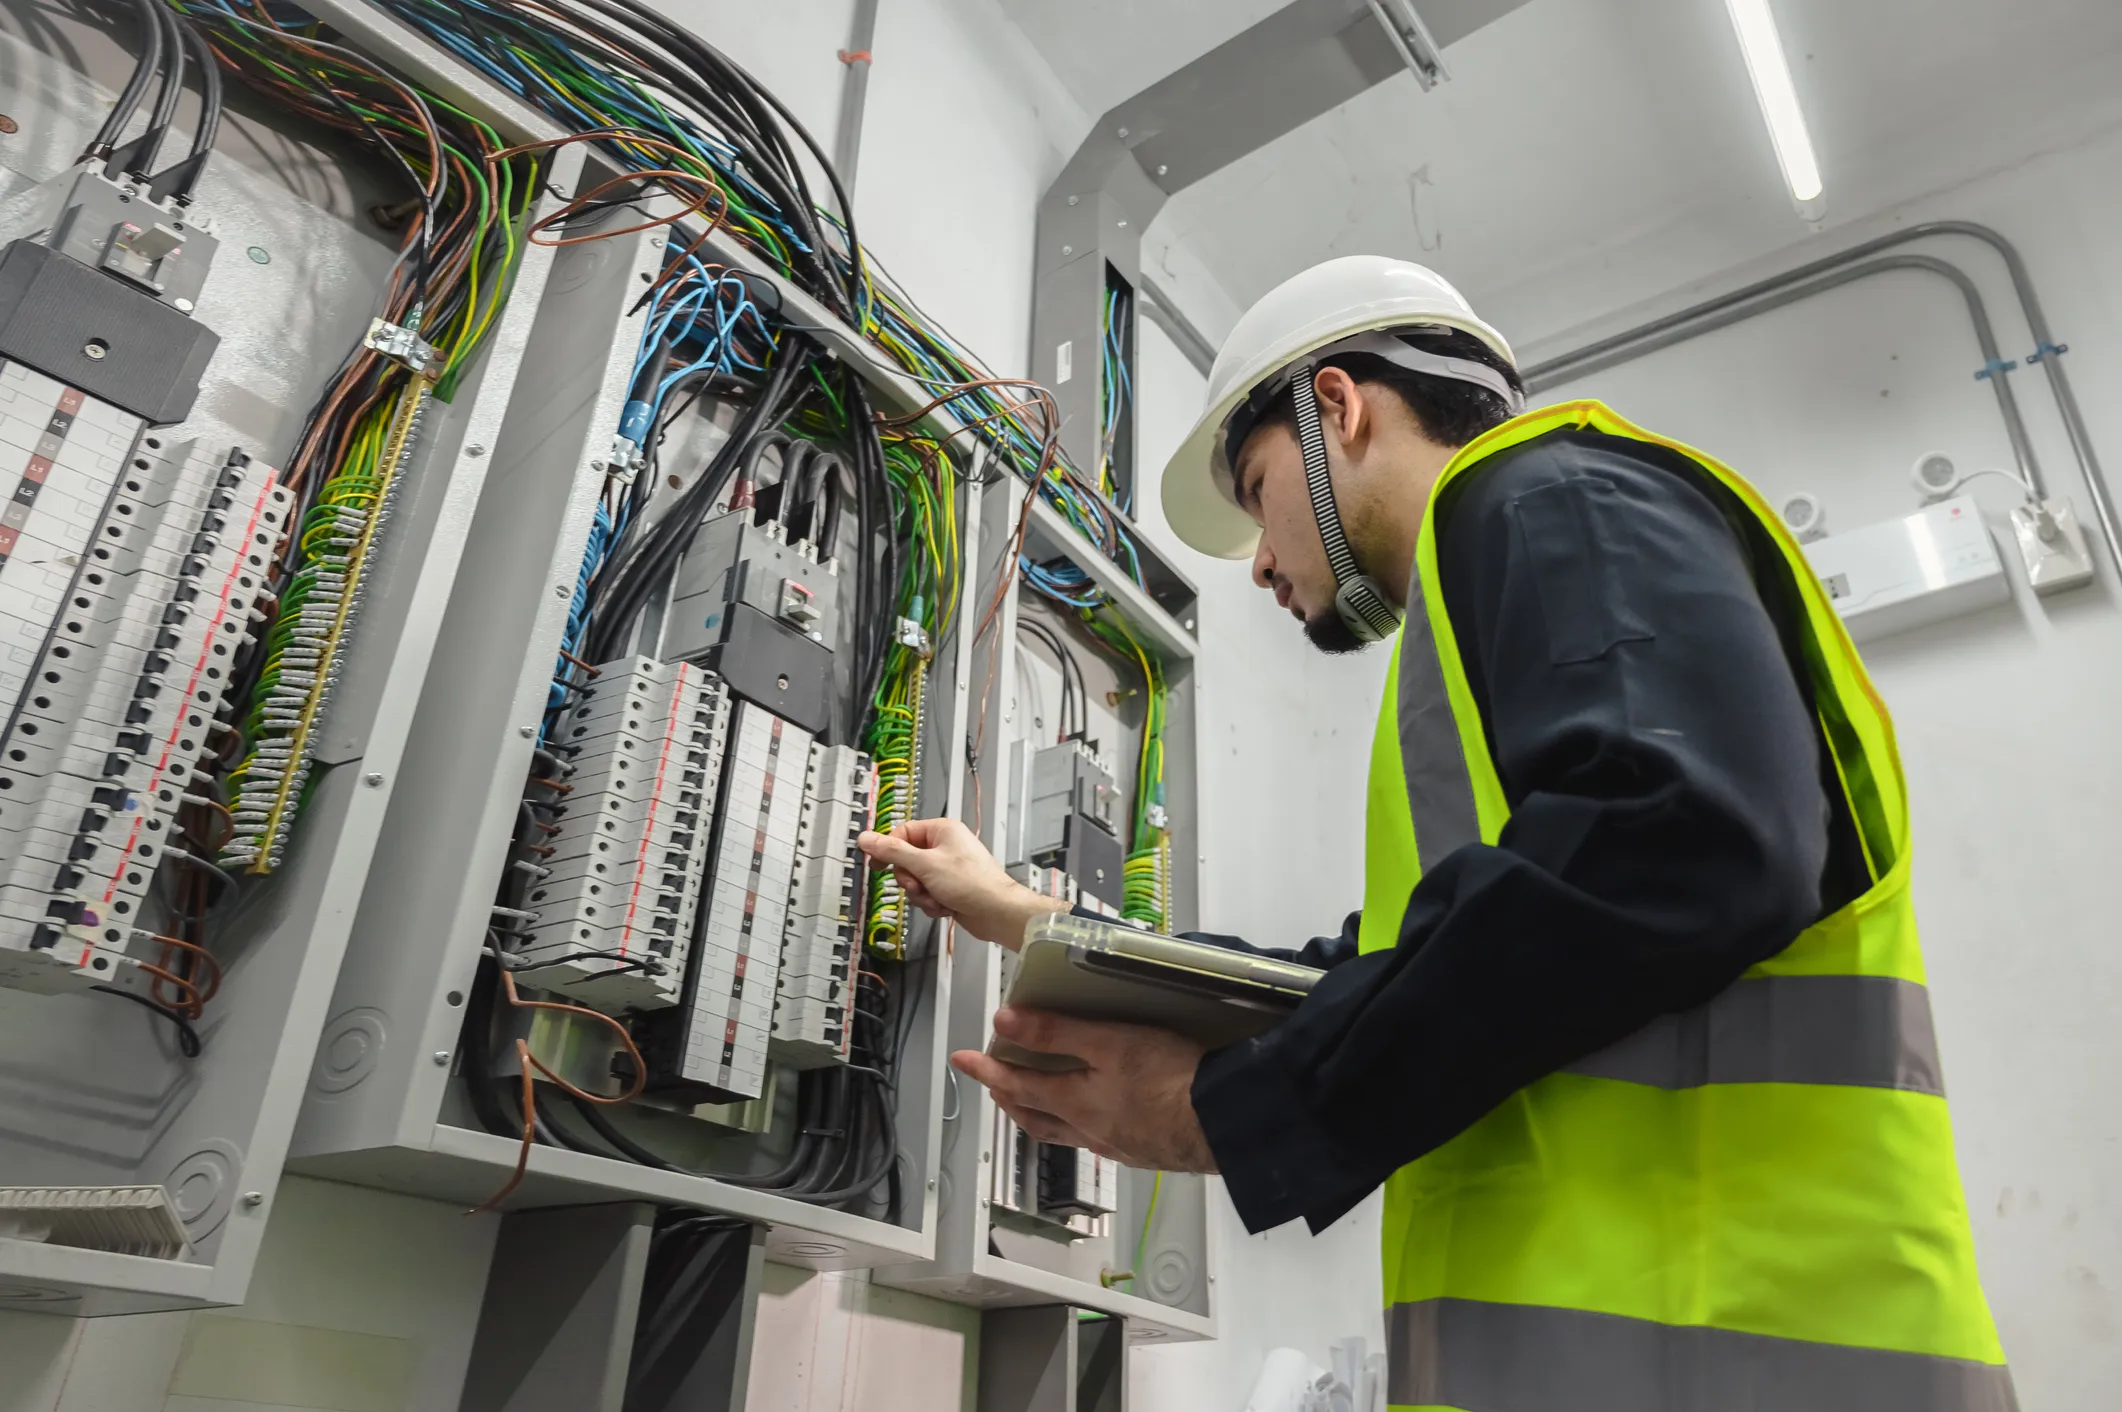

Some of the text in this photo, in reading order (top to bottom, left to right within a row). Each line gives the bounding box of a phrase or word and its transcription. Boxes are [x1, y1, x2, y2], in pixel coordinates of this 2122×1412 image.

[52, 418, 68, 429] L2
[29, 464, 44, 473] L1
[19, 487, 35, 498] L2
